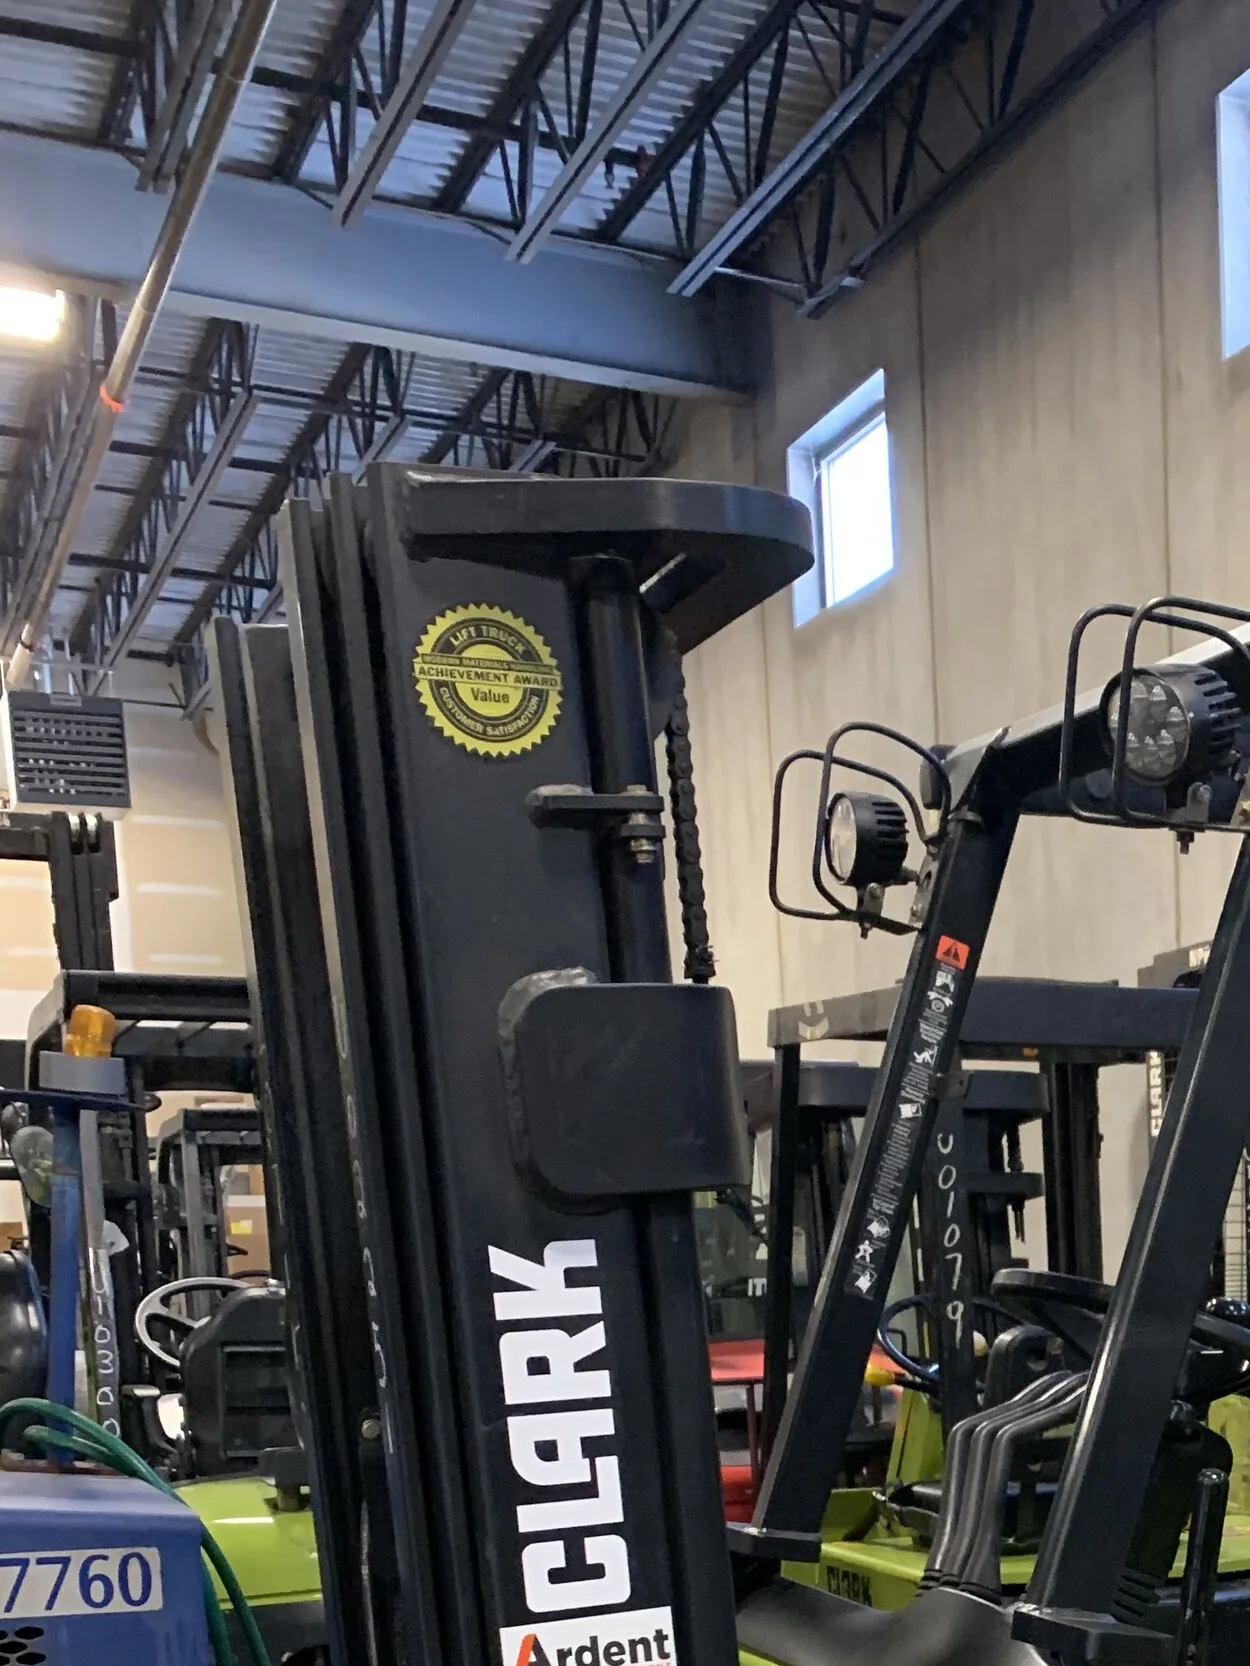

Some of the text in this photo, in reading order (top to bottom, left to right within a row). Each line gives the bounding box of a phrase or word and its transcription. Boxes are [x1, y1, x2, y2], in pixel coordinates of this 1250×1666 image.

[450, 625, 526, 654] LIFT TRUCK
[418, 666, 559, 687] ACHIEVEMENT AWARD
[471, 687, 510, 704] Value
[440, 687, 540, 736] CUSTOMER SATISFACTION
[488, 1237, 631, 1613] CLARK
